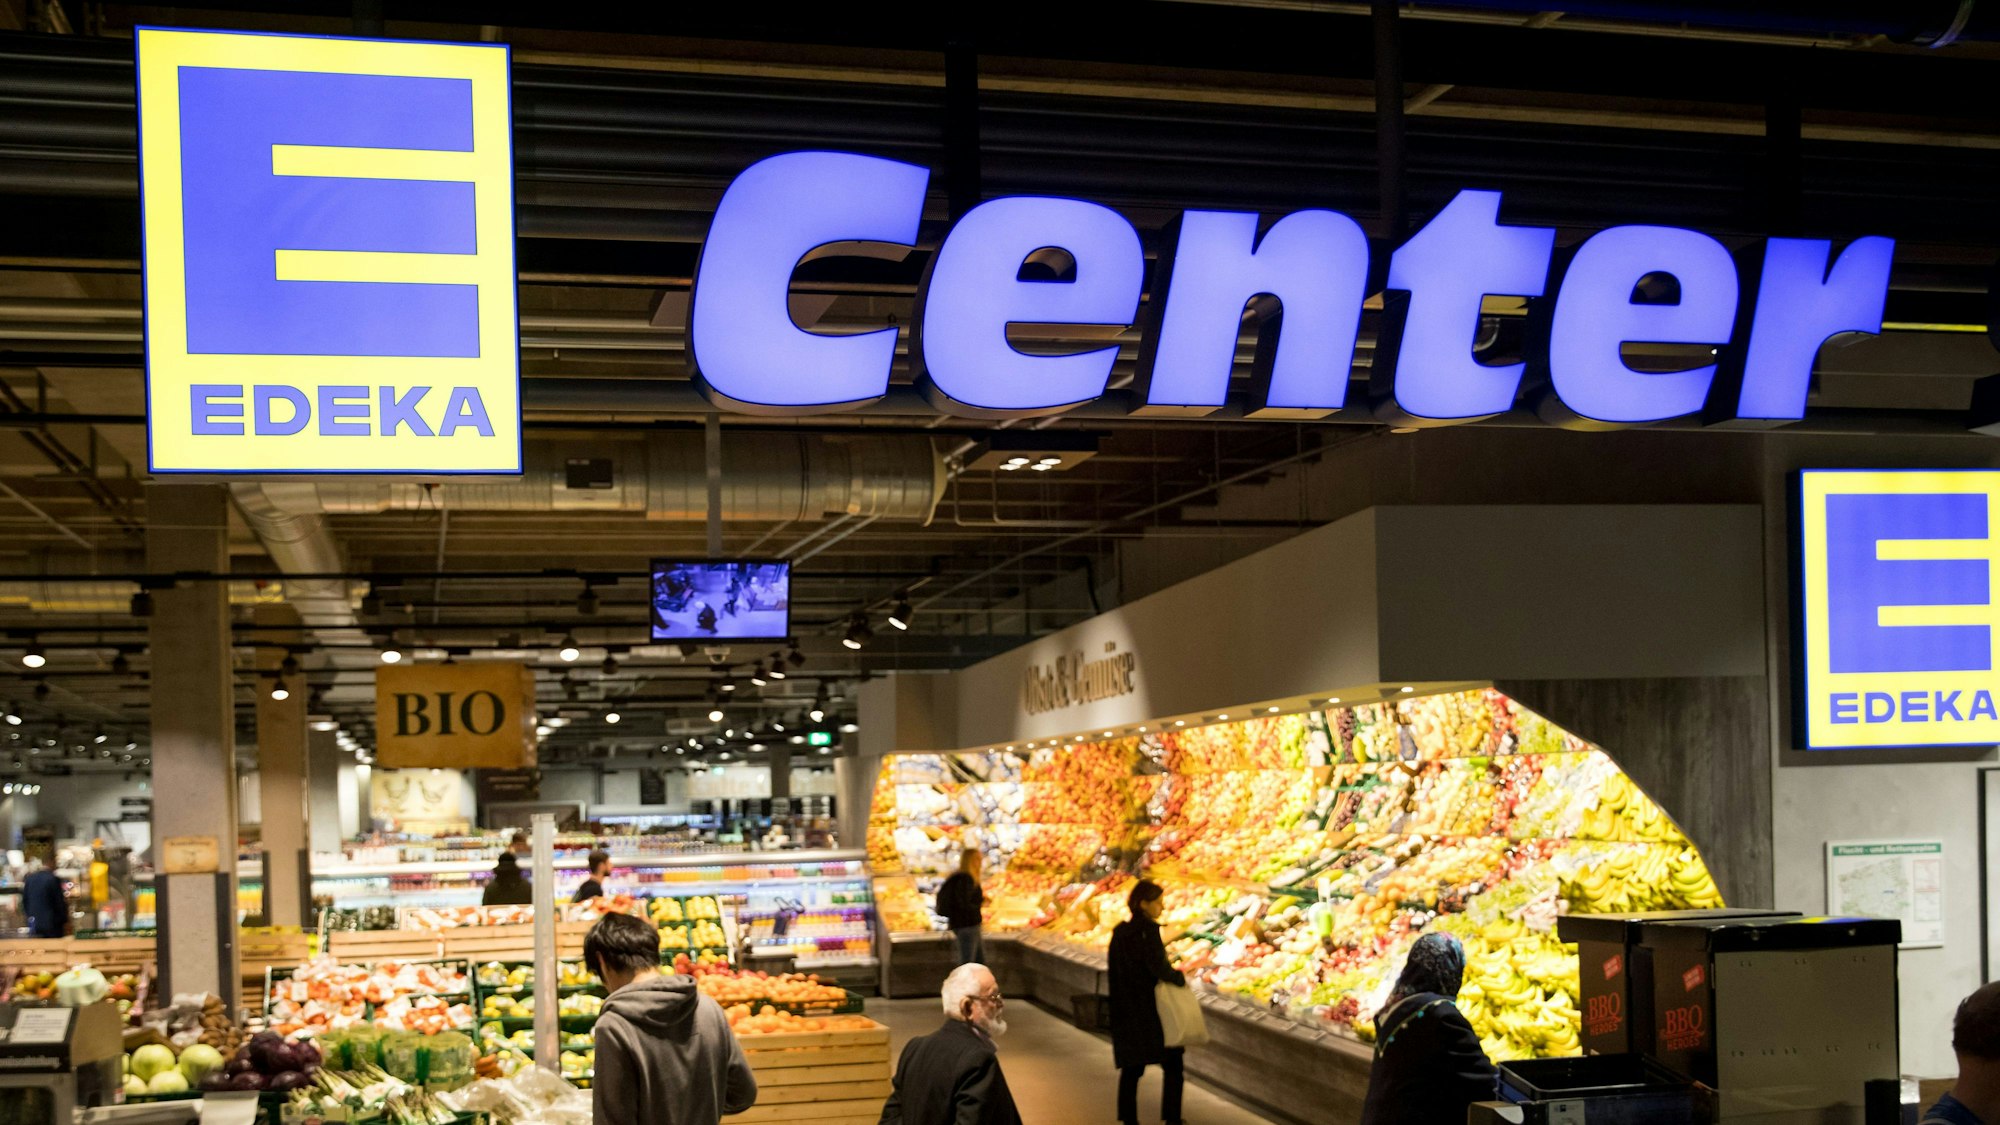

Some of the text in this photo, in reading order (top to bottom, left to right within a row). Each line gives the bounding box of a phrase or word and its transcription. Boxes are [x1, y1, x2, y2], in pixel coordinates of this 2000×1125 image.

[178, 66, 480, 358] E
[692, 151, 1895, 422] Center
[190, 384, 495, 437] EDEKA
[1826, 493, 1992, 674] E
[1024, 640, 1135, 715] Obst & Gemüse
[393, 690, 506, 736] BIO
[1829, 689, 1999, 725] EDEKA
[1838, 846, 1863, 855] Flucht
[1870, 845, 1885, 853] und
[1588, 991, 1621, 1021] BBQ
[1665, 1004, 1703, 1034] BBQ
[1590, 1021, 1618, 1036] HEROES
[1667, 1036, 1700, 1051] HEROES
